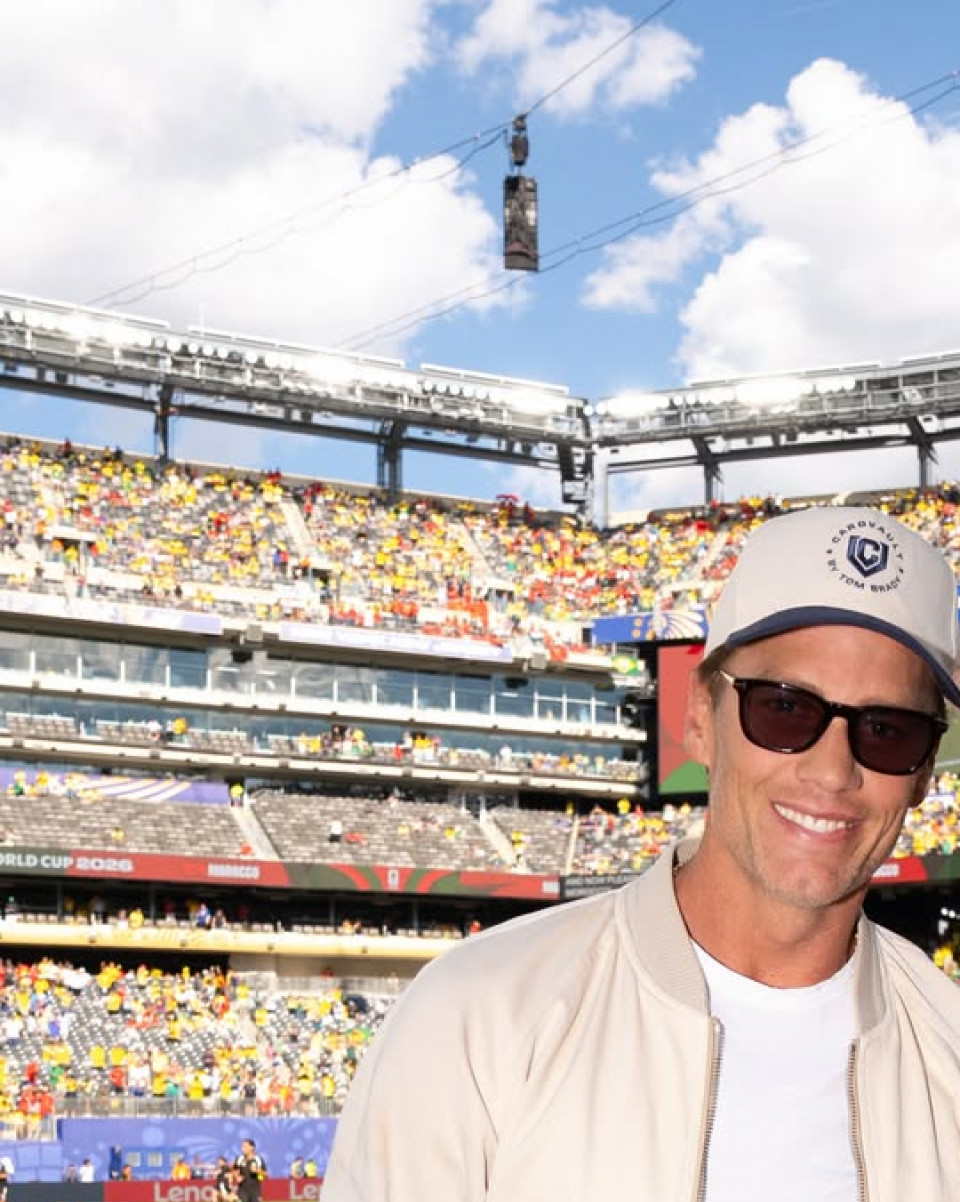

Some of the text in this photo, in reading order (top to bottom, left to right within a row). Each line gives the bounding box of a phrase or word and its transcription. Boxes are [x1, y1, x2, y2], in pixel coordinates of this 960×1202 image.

[839, 574, 865, 589] TOM
[41, 854, 73, 869] CUP
[153, 1182, 214, 1202] Leno
